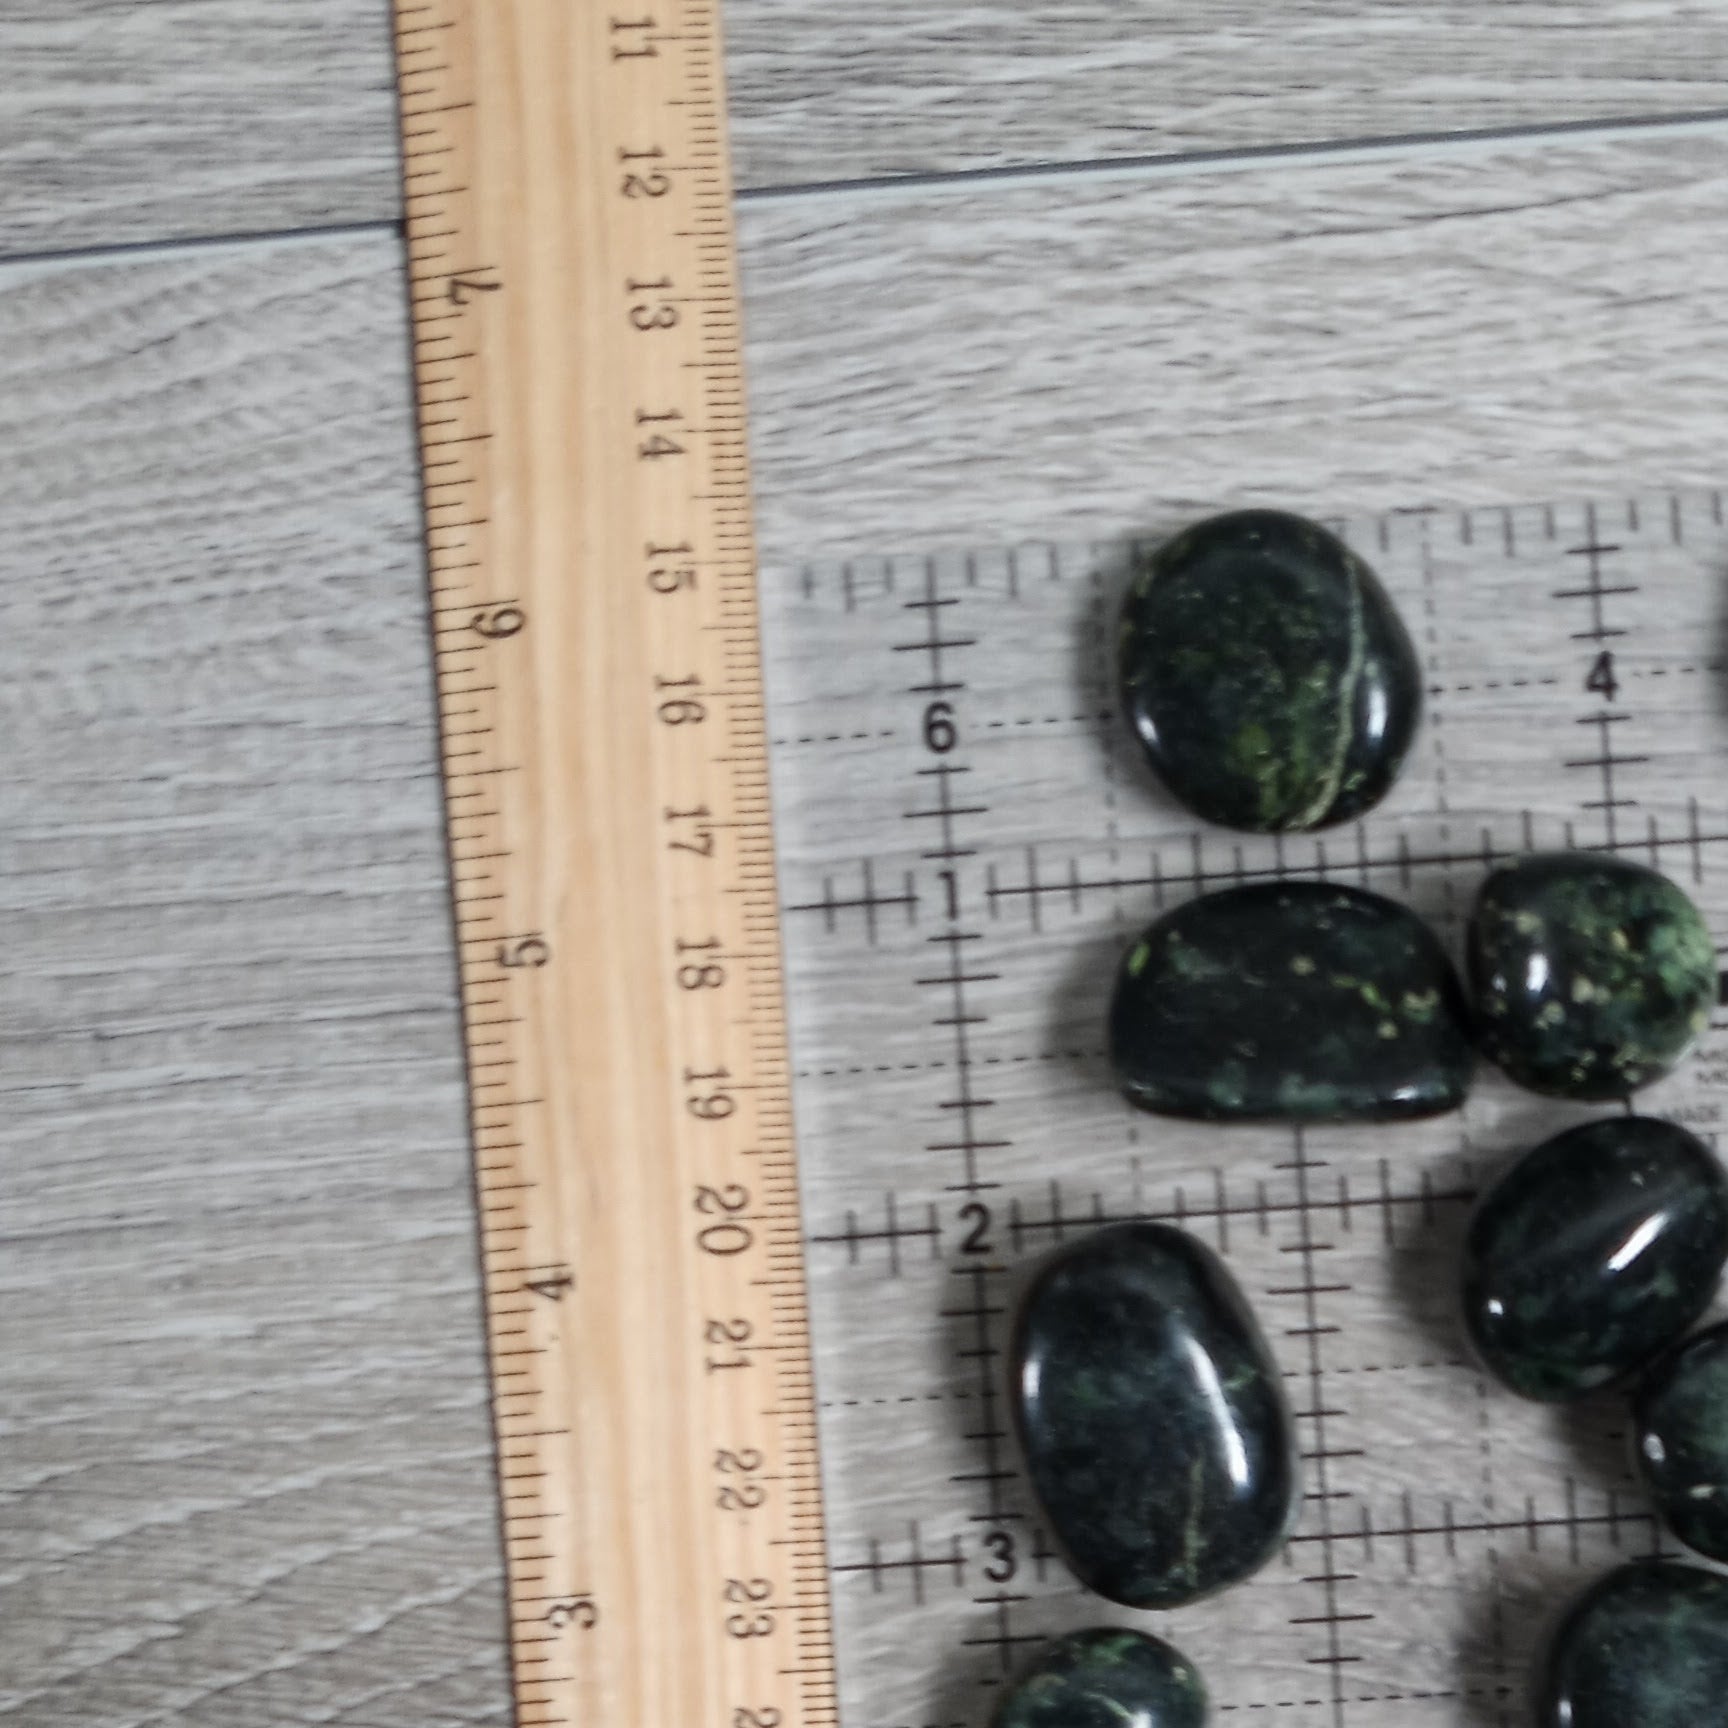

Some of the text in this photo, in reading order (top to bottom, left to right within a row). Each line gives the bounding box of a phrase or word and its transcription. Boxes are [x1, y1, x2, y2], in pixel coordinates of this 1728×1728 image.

[610, 16, 659, 63] 11
[617, 145, 671, 199] 12
[450, 276, 503, 306] 7
[626, 275, 679, 331] 13
[636, 407, 688, 461] 14
[645, 540, 696, 594] 15
[472, 607, 525, 639] 6
[654, 673, 707, 727] 16
[1586, 651, 1618, 702] 4
[924, 701, 958, 754] 6
[664, 805, 715, 858] 17
[937, 870, 959, 920] 1
[498, 938, 551, 970] 5
[675, 935, 727, 990] 18
[684, 1065, 736, 1120] 19
[694, 1183, 754, 1257] 20
[957, 1202, 992, 1255] 2
[524, 1271, 575, 1302] 4
[704, 1318, 754, 1376] 21
[712, 1447, 768, 1512] 22
[983, 1530, 1017, 1583] 3
[547, 1599, 597, 1631] 3
[724, 1577, 776, 1641] 23
